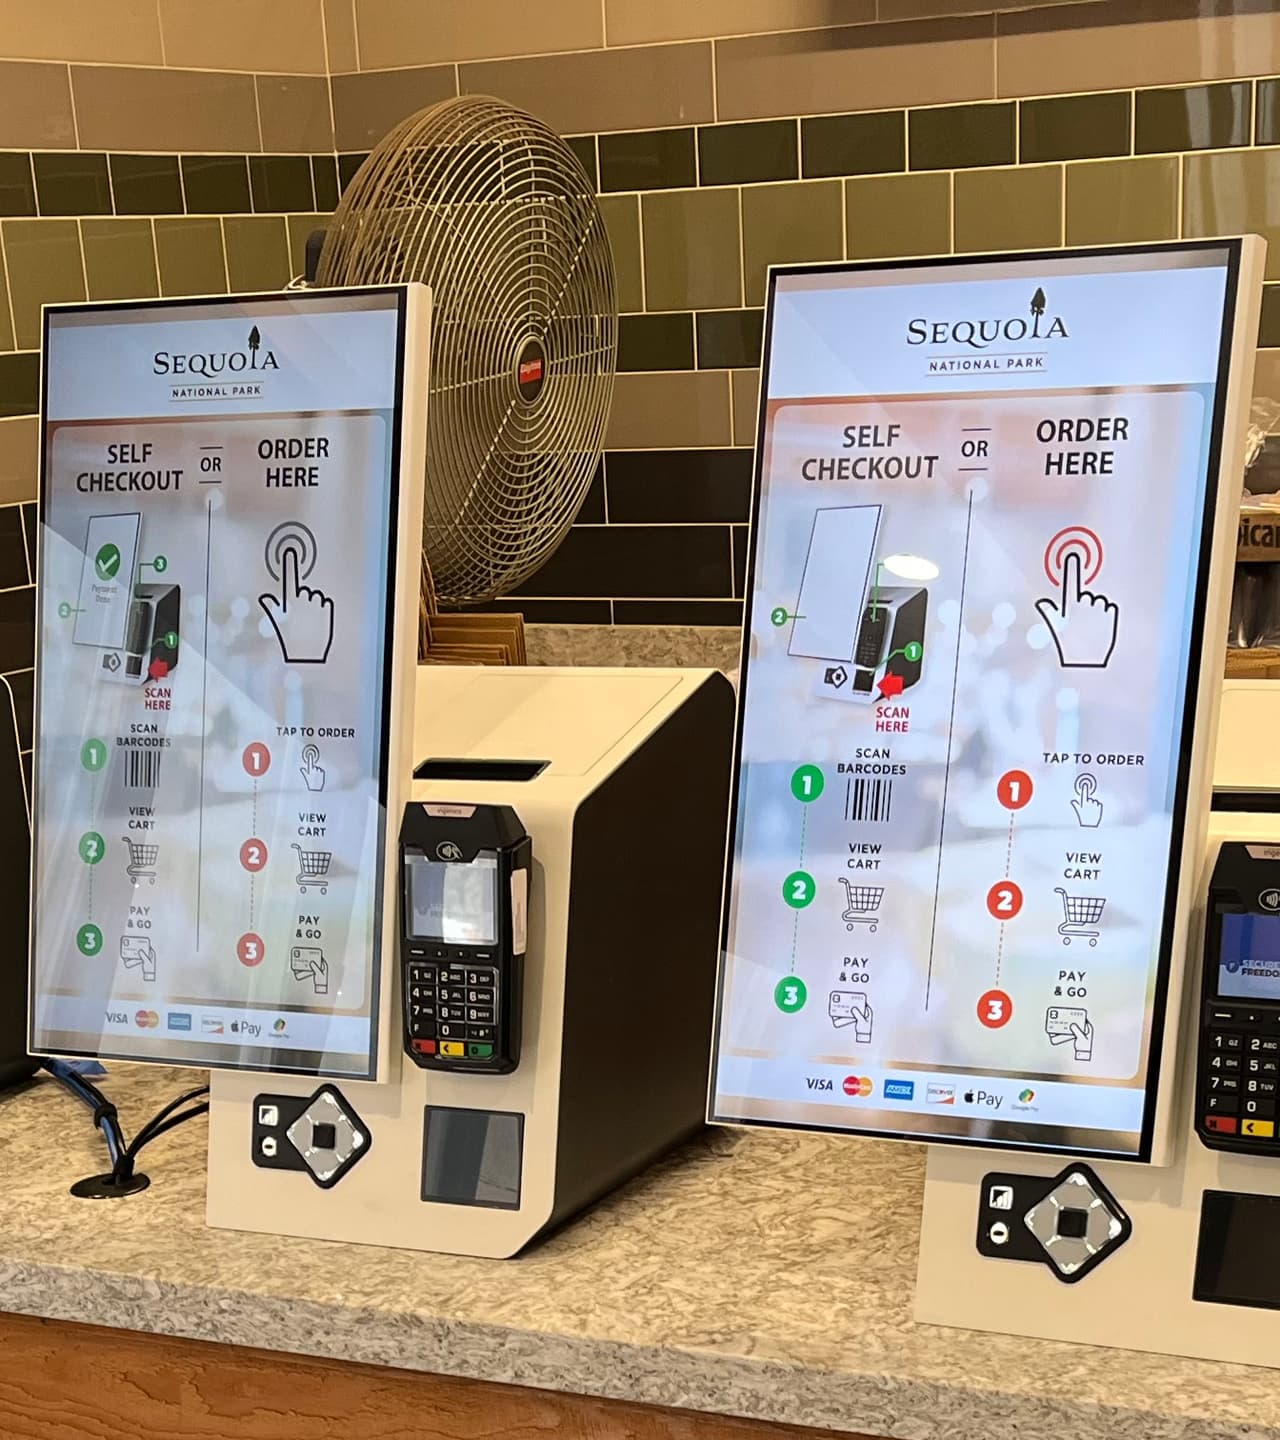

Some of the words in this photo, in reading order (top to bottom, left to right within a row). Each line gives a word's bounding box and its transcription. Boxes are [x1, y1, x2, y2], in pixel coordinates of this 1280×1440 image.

[907, 303, 1069, 348] SEQUOIA
[153, 340, 280, 378] SEQUOIA
[929, 358, 1000, 372] NATIONAL
[1007, 356, 1044, 369] PARK
[172, 387, 227, 397] NATIONAL
[232, 385, 261, 395] PARK
[1036, 417, 1129, 443] ORDER
[842, 424, 901, 449] SELF
[107, 444, 152, 464] SELF
[258, 439, 329, 459] ORDER
[961, 439, 989, 458] OR
[200, 457, 222, 472] OR
[801, 456, 939, 481] CHECKOUT
[1045, 452, 1114, 476] HERE
[77, 471, 183, 492] CHECKOUT
[265, 467, 319, 488] HERE
[157, 559, 163, 569] 3
[775, 612, 783, 622] 2
[145, 688, 171, 698] SCAN
[145, 700, 170, 710] HERE
[876, 707, 909, 718] SCAN
[130, 724, 158, 733] SCAN
[876, 721, 909, 732] HERE
[276, 727, 297, 737] TAP
[300, 727, 315, 737] TO
[318, 727, 355, 738] ORDER
[116, 737, 171, 747] BARCODES
[89, 749, 97, 764] 1
[855, 749, 890, 760] SCAN
[1043, 753, 1070, 765] TAP
[1074, 753, 1092, 764] TO
[1097, 753, 1144, 766] ORDER
[252, 753, 259, 768] 1
[837, 763, 906, 775] BARCODES
[801, 776, 813, 794] 1
[1009, 782, 1021, 802] 1
[129, 807, 156, 817] VIEW
[299, 813, 326, 823] VIEW
[128, 819, 155, 829] CART
[298, 827, 326, 837] CART
[86, 841, 97, 856] 2
[848, 843, 882, 855] VIEW
[248, 848, 260, 864] 2
[1066, 853, 1102, 865] VIEW
[847, 858, 881, 870] CART
[1064, 868, 1101, 880] CART
[792, 882, 806, 899] 2
[997, 892, 1012, 910] 2
[130, 906, 149, 916] PAY
[137, 919, 152, 928] GO
[299, 916, 319, 926] PAY
[296, 929, 304, 938] &
[306, 929, 321, 939] GO
[84, 932, 95, 948] 3
[245, 942, 257, 958] 3
[843, 957, 868, 968] PAY
[414, 970, 418, 980] 1
[441, 972, 448, 981] 2
[470, 974, 476, 983] 3
[840, 973, 849, 983] &
[852, 973, 870, 983] GO
[1059, 971, 1086, 983] PAY
[413, 988, 419, 997] 4
[442, 990, 448, 999] 5
[784, 987, 798, 1005] 3
[1054, 987, 1063, 997] &
[1068, 987, 1087, 998] GO
[413, 1006, 419, 1015] 7
[442, 1008, 448, 1017] 8
[470, 1010, 476, 1019] 9
[987, 1000, 1002, 1020] 3
[106, 1012, 128, 1024] VISA
[241, 1023, 261, 1037] Pay
[442, 1025, 449, 1035] 0
[1215, 1036, 1222, 1047] 1
[1251, 1039, 1260, 1050] 2
[1212, 1057, 1220, 1068] 4
[1250, 1060, 1258, 1071] 5
[806, 1078, 833, 1091] VISA
[1211, 1077, 1219, 1088] 7
[1248, 1081, 1257, 1091] 8
[887, 1086, 911, 1094] AMEX
[977, 1091, 1003, 1109] Pay
[1210, 1099, 1216, 1107] F
[1247, 1102, 1256, 1112] 0
